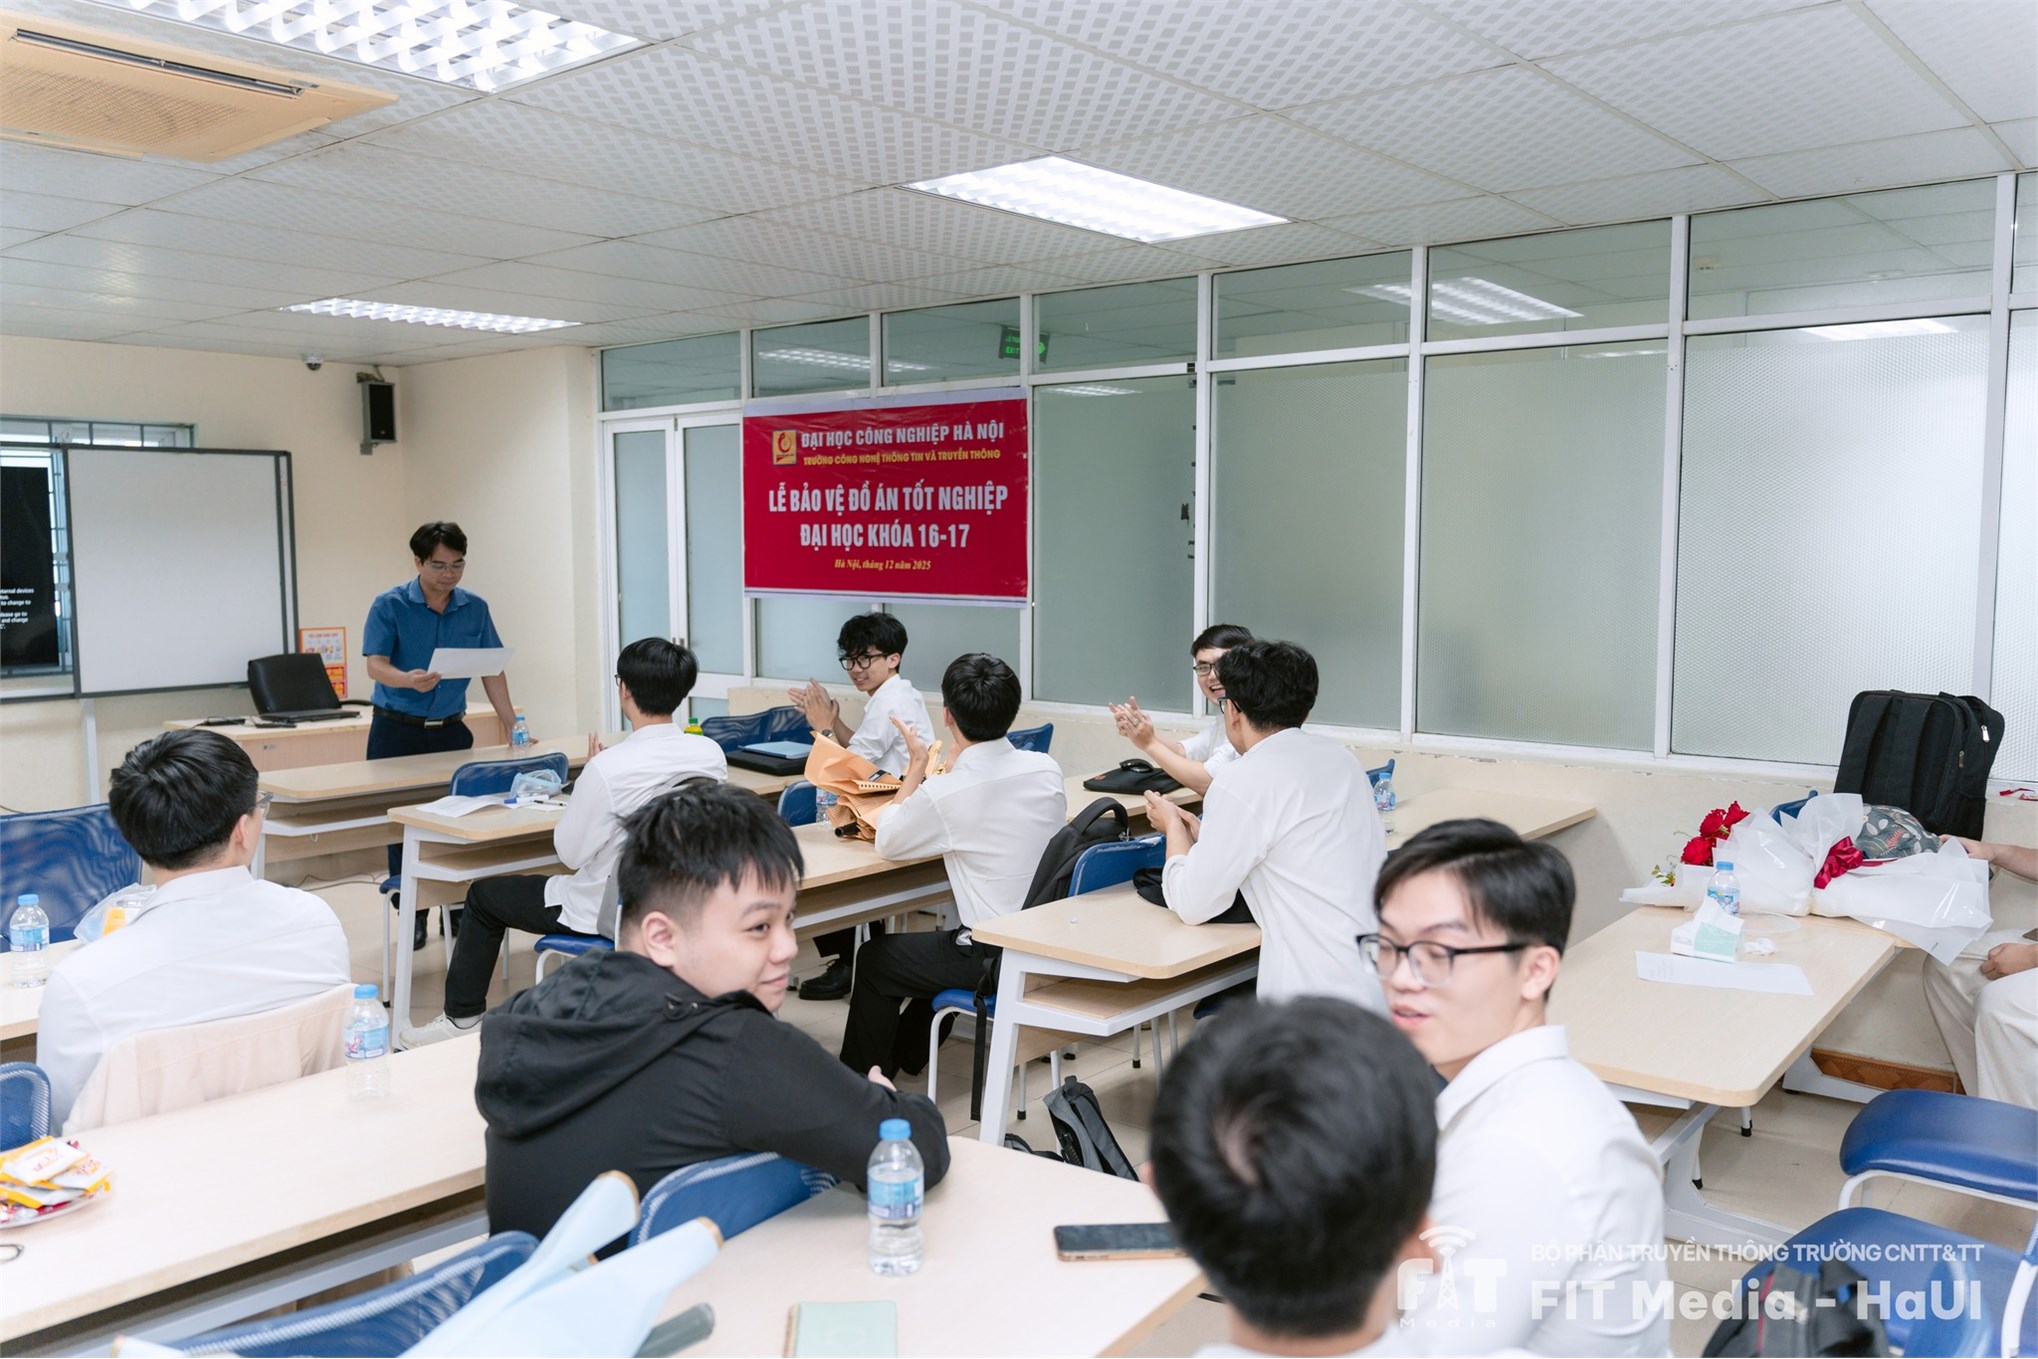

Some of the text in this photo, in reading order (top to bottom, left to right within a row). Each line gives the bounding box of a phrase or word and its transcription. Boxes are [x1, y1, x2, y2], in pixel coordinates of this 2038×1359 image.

[801, 420, 1004, 450] ĐẠI HỌC CÔNG NGHIỆP HÀ NỘI
[834, 454, 858, 464] CÔNG
[882, 452, 910, 463] THÔNG
[911, 452, 923, 461] TIN
[970, 448, 1001, 459] THÔNG
[769, 479, 1008, 516] LỄ BẢO VỆ ĐỒ ÁN TỐT NGHIỆP
[800, 519, 970, 552] ĐẠI HỌC KHÓA 16-17
[885, 560, 894, 569] 12
[912, 560, 931, 570] 2025
